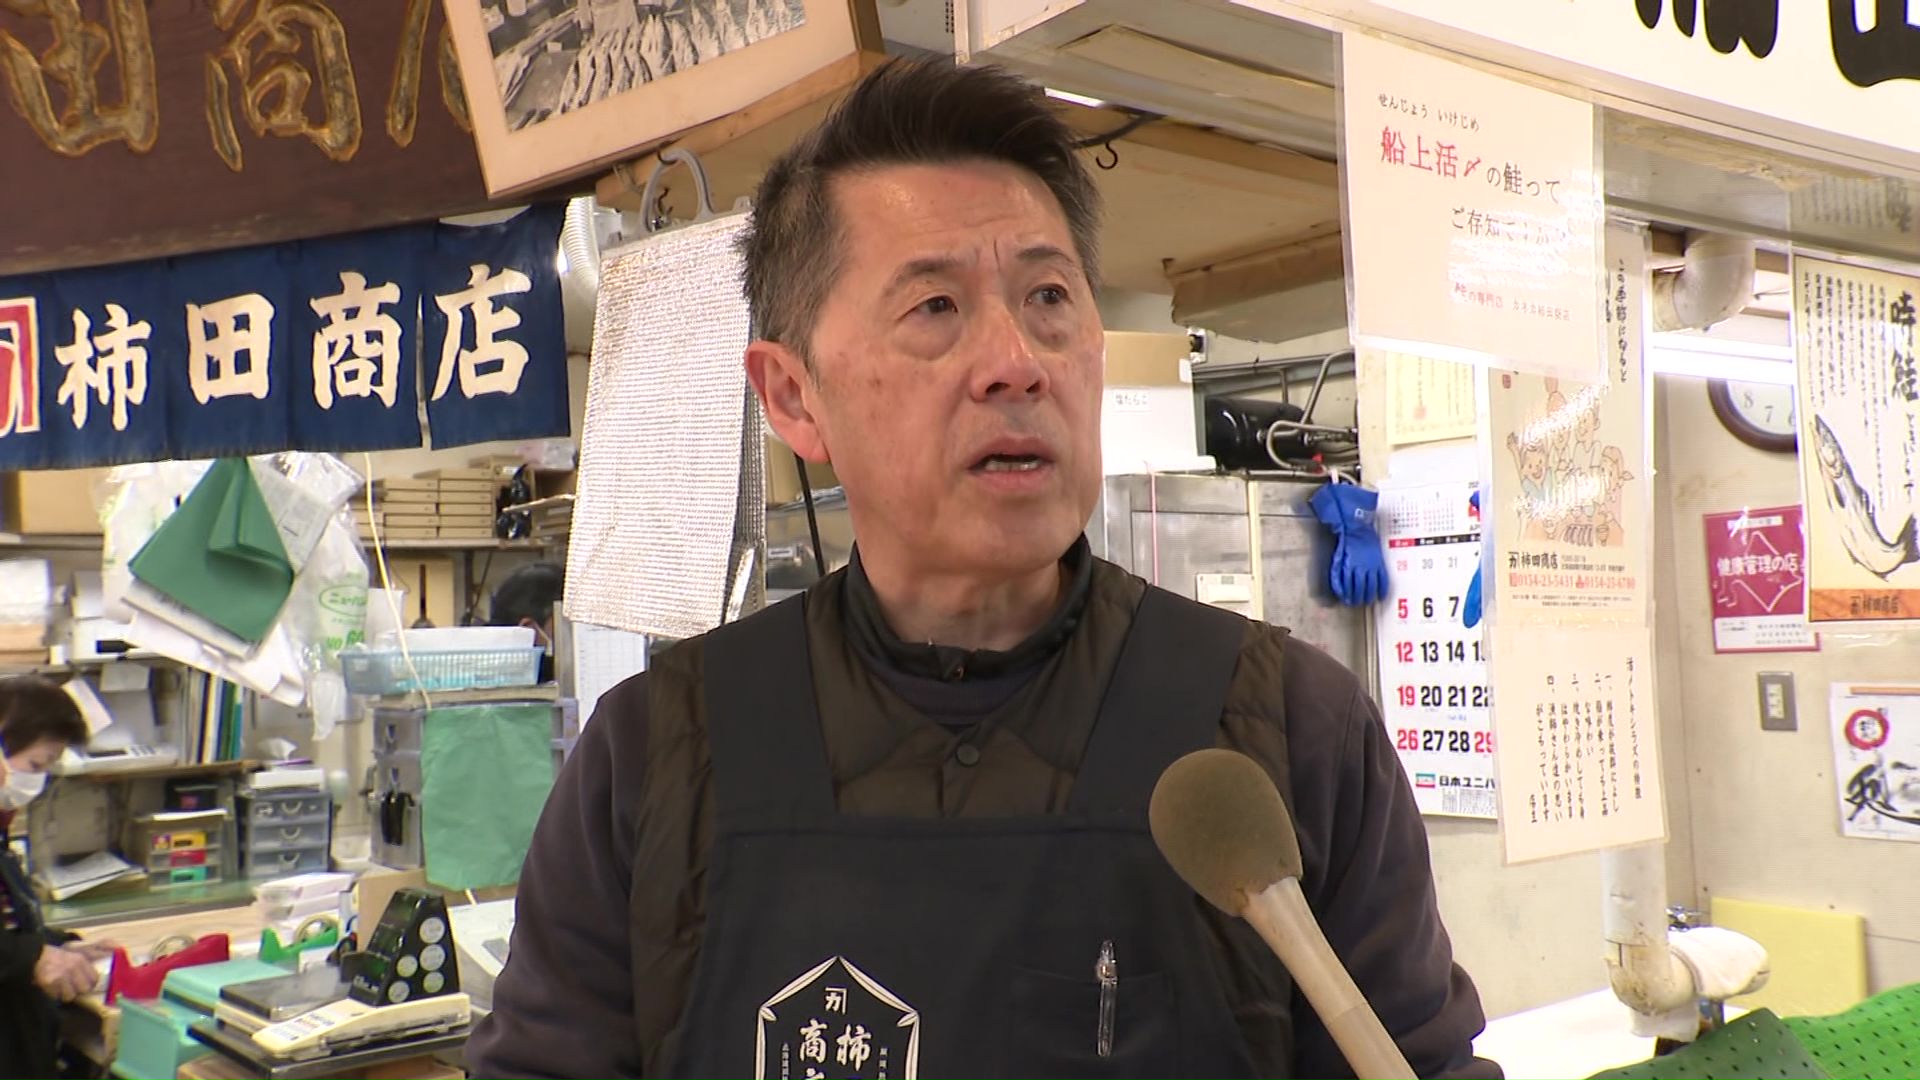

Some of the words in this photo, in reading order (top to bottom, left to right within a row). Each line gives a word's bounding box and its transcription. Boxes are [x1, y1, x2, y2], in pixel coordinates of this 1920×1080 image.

[1379, 93, 1428, 118] せんじょう
[1438, 109, 1480, 131] いけじめ
[55, 264, 532, 431] 柿田商店
[1764, 405, 1773, 422] 7
[1422, 558, 1433, 570] 30
[1717, 552, 1799, 577] 健康管理の店
[1397, 598, 1409, 619] 5
[1422, 597, 1434, 618] 6
[1448, 596, 1460, 618] 7
[1395, 641, 1414, 663] 12
[1420, 641, 1439, 663] 13
[1446, 640, 1465, 663] 14
[1397, 685, 1415, 706] 19
[1420, 685, 1442, 707] 20
[1448, 685, 1467, 707] 21
[1396, 728, 1419, 751] 26
[1422, 730, 1444, 751] 27
[1448, 730, 1470, 753] 28
